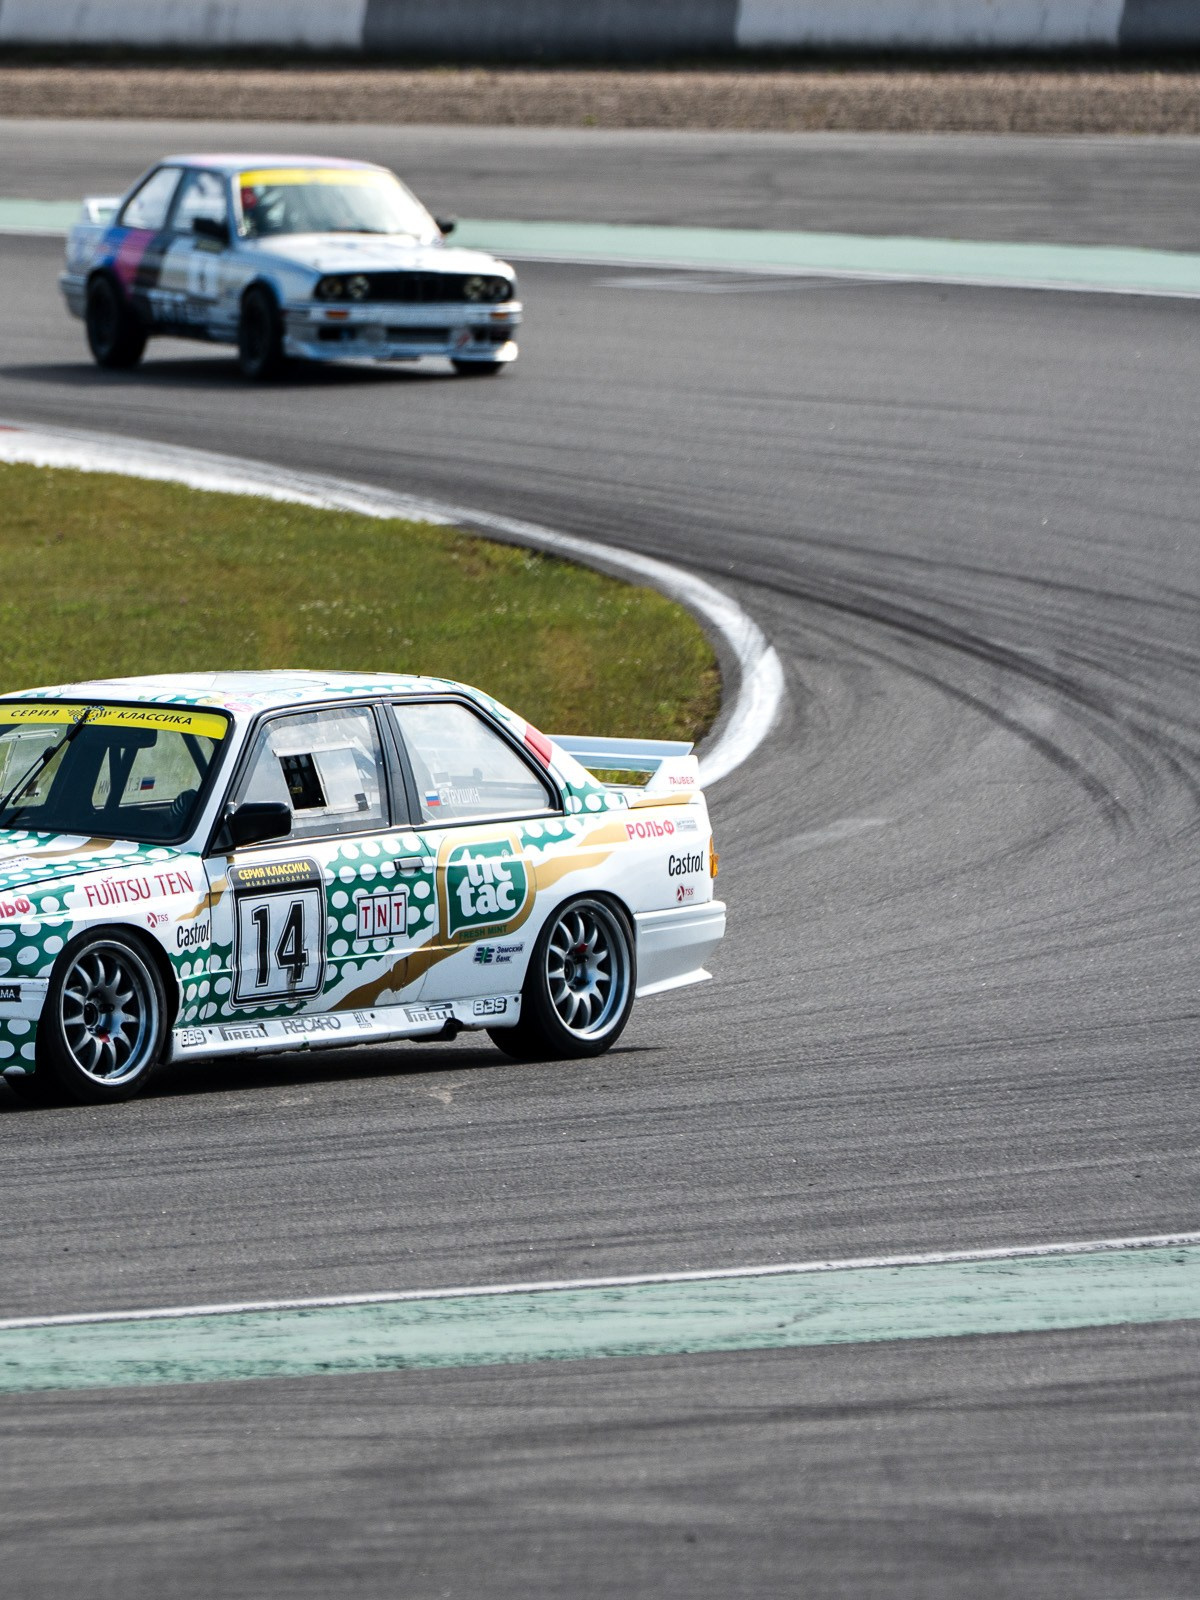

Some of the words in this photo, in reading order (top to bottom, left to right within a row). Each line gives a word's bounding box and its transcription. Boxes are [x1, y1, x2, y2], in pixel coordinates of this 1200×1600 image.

[10, 709, 60, 718] СЕРИЯ
[117, 711, 193, 726] КЛАССИКА
[625, 819, 675, 840] РОЛЬФ
[238, 867, 266, 881] СЕРИЯ
[265, 861, 312, 877] КЛАССИКА
[460, 848, 512, 887] tic
[668, 850, 704, 877] Castrol
[154, 870, 194, 897] TEN
[456, 876, 516, 917] tac
[361, 902, 403, 930] TNT
[176, 920, 210, 949] Castrol
[459, 928, 486, 940] FRESH
[488, 924, 508, 935] MINT
[251, 900, 309, 988] 14
[496, 944, 524, 955] Земский
[496, 954, 512, 964] банк
[403, 1003, 456, 1023] PIRELLI
[473, 997, 507, 1016] BBS
[219, 1022, 270, 1042] PIRELLI
[281, 1015, 342, 1035] RECARO
[181, 1030, 208, 1048] BBS
